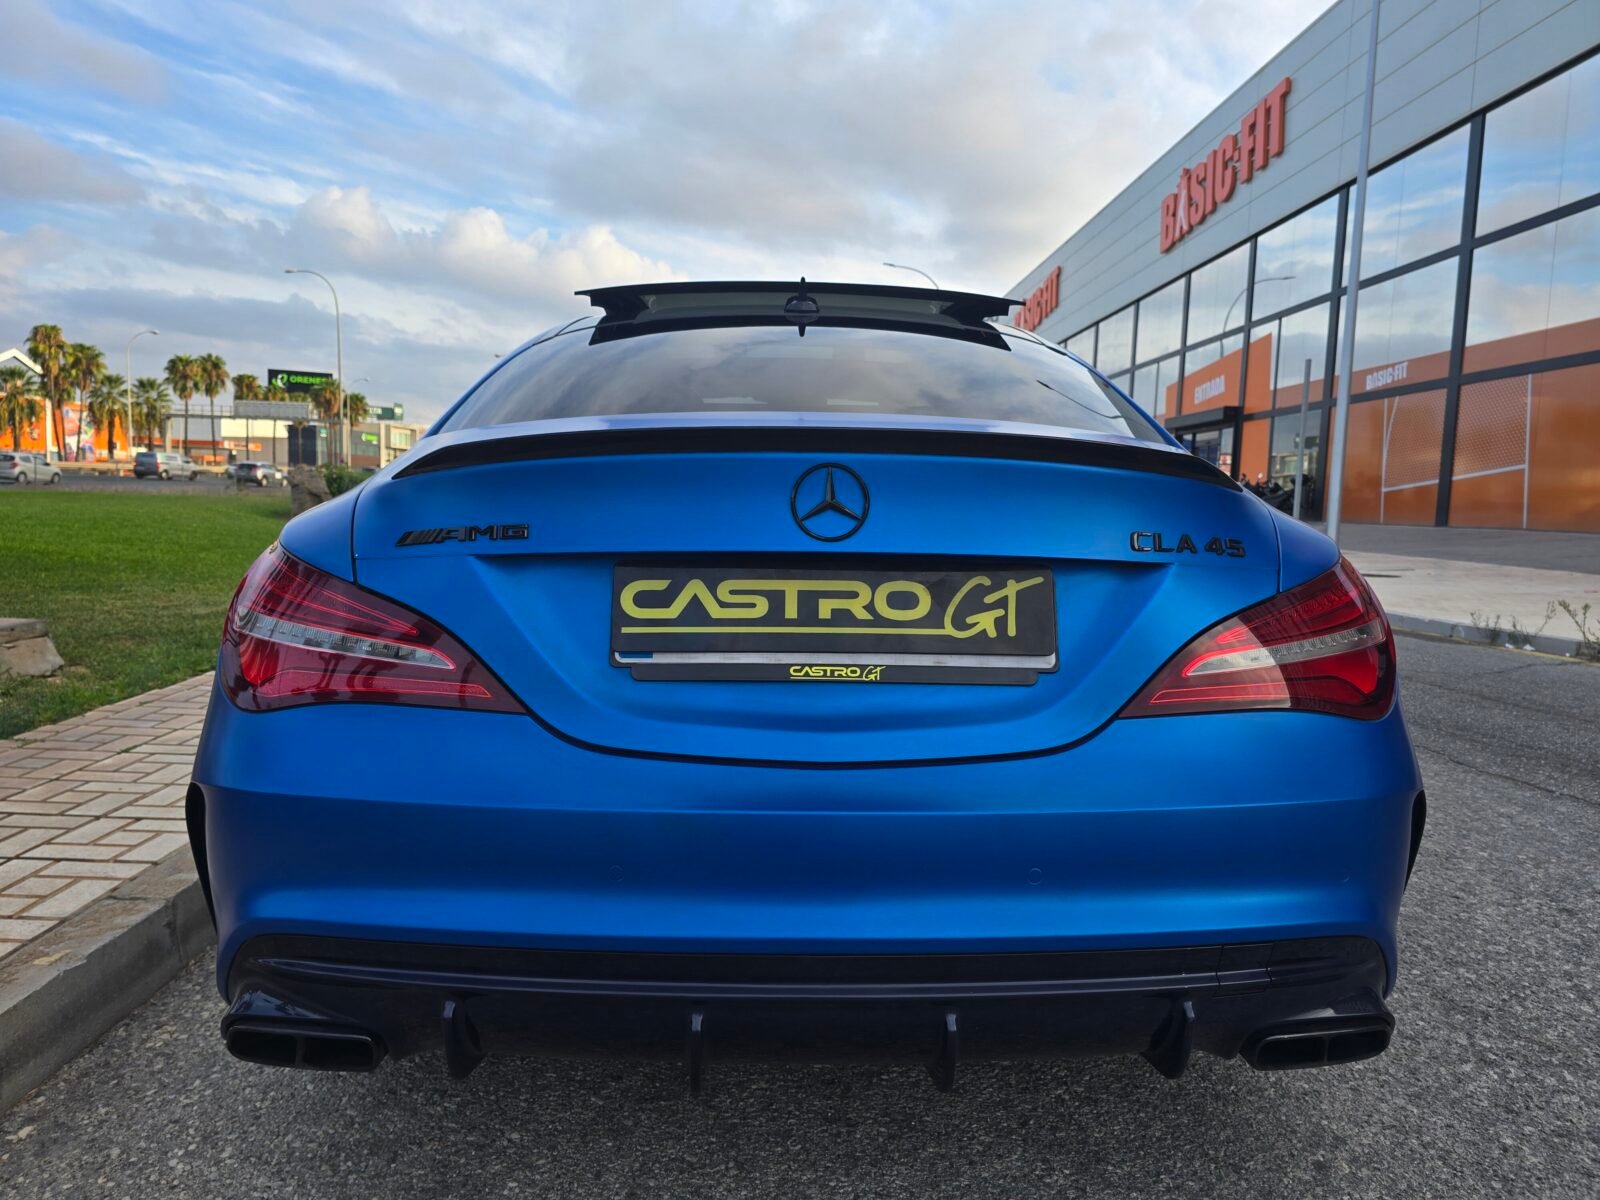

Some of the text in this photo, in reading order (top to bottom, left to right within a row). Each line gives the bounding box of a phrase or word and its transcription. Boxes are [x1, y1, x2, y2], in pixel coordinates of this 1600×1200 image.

[1129, 531, 1246, 558] CLA 45
[620, 576, 1045, 639] CASTRO GT
[789, 665, 887, 681] CASTRO GT
